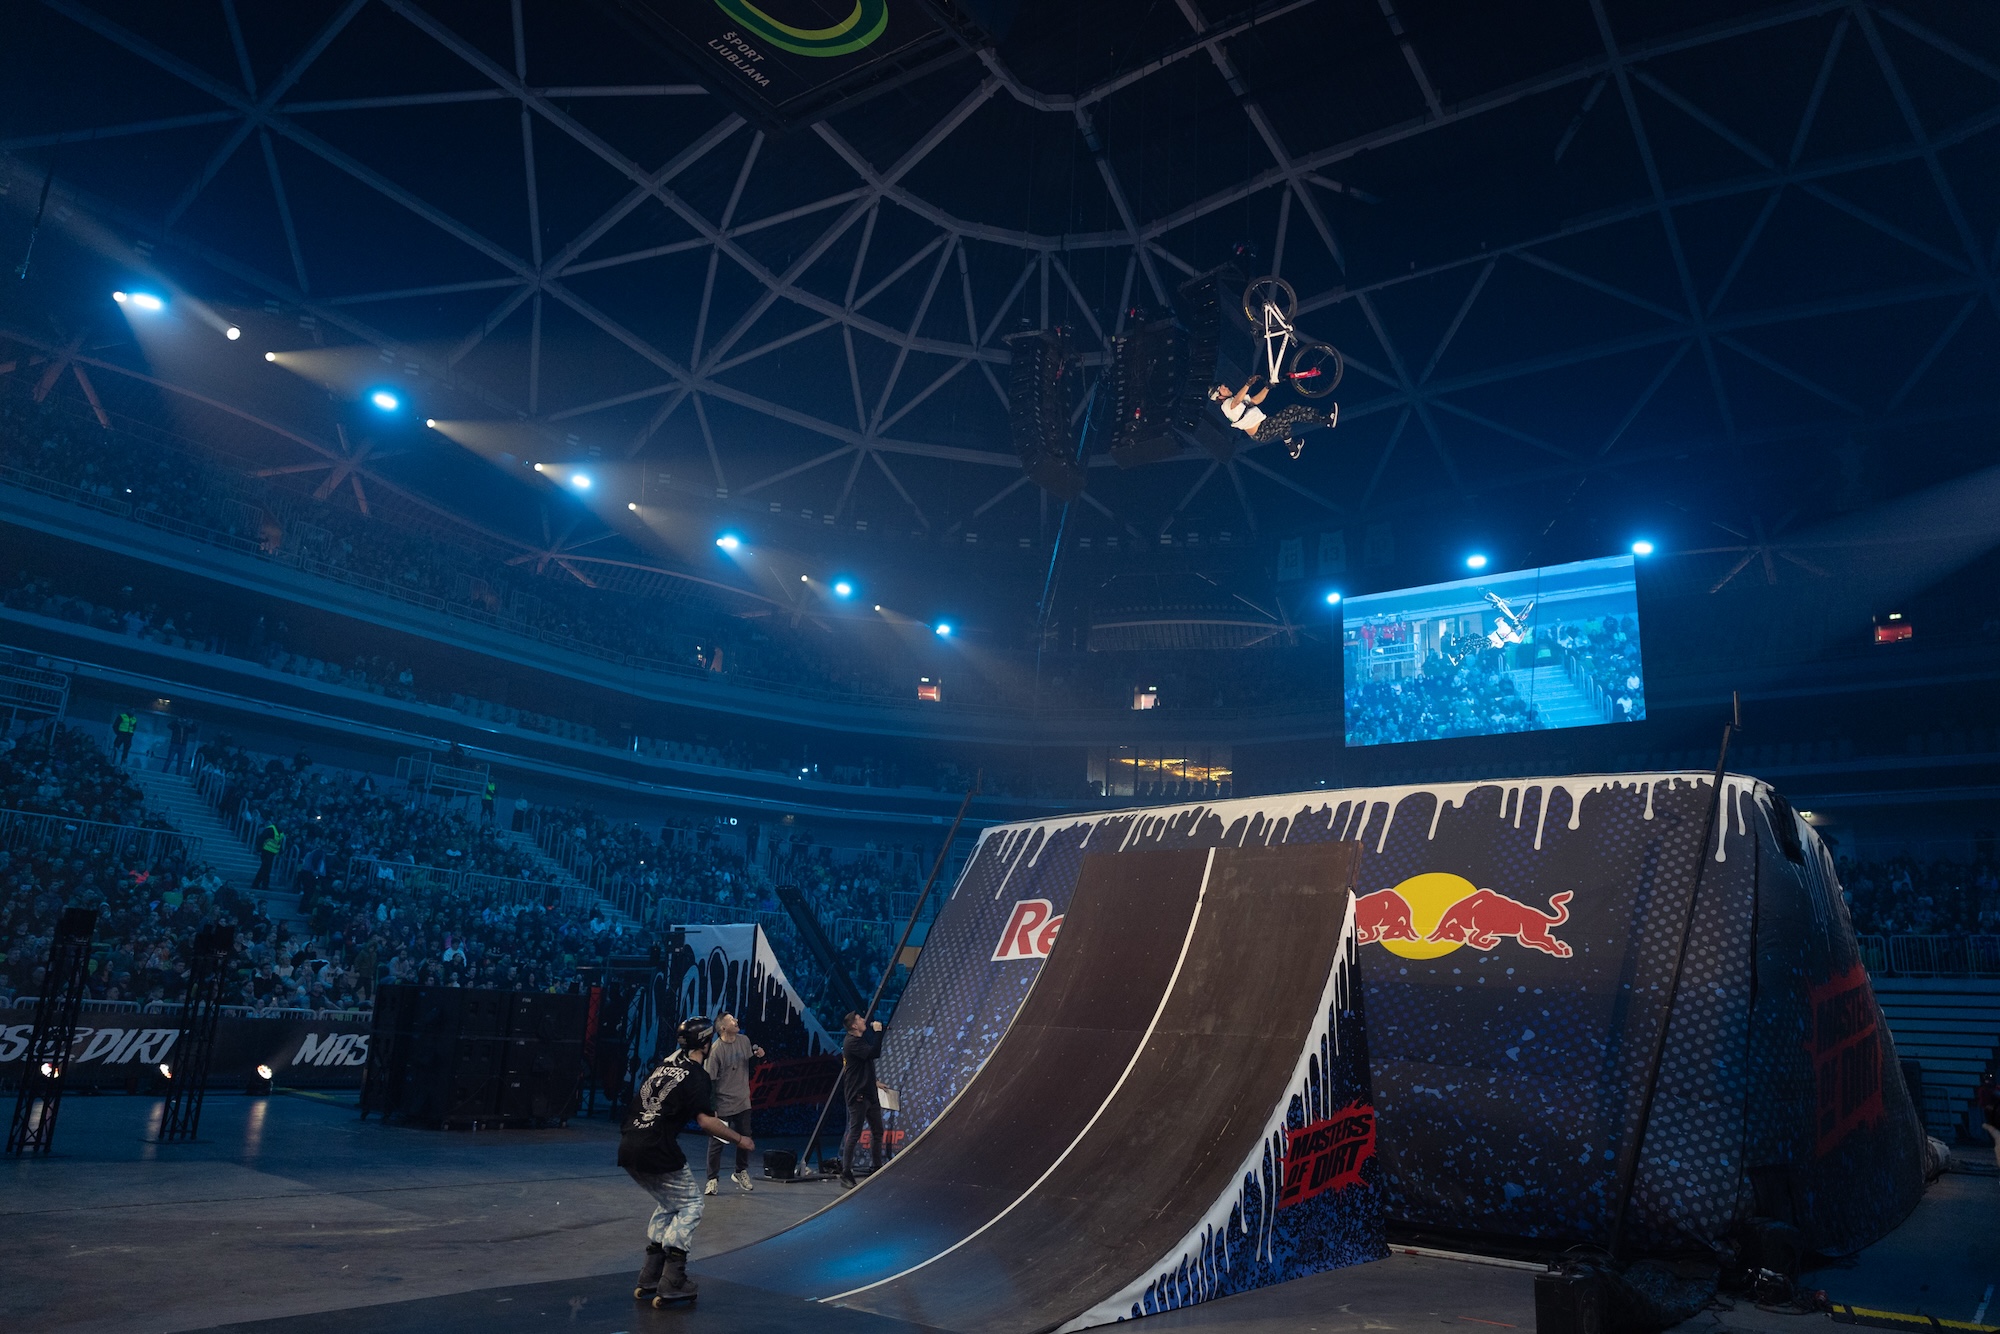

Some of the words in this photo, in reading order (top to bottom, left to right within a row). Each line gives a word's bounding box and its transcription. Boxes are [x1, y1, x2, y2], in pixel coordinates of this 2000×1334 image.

[707, 39, 771, 88] LJUBLJANA
[722, 31, 765, 63] ŠPORT
[1289, 1113, 1373, 1163] MASTERS
[1286, 1160, 1310, 1187] OF
[1309, 1138, 1369, 1190] DIRT
